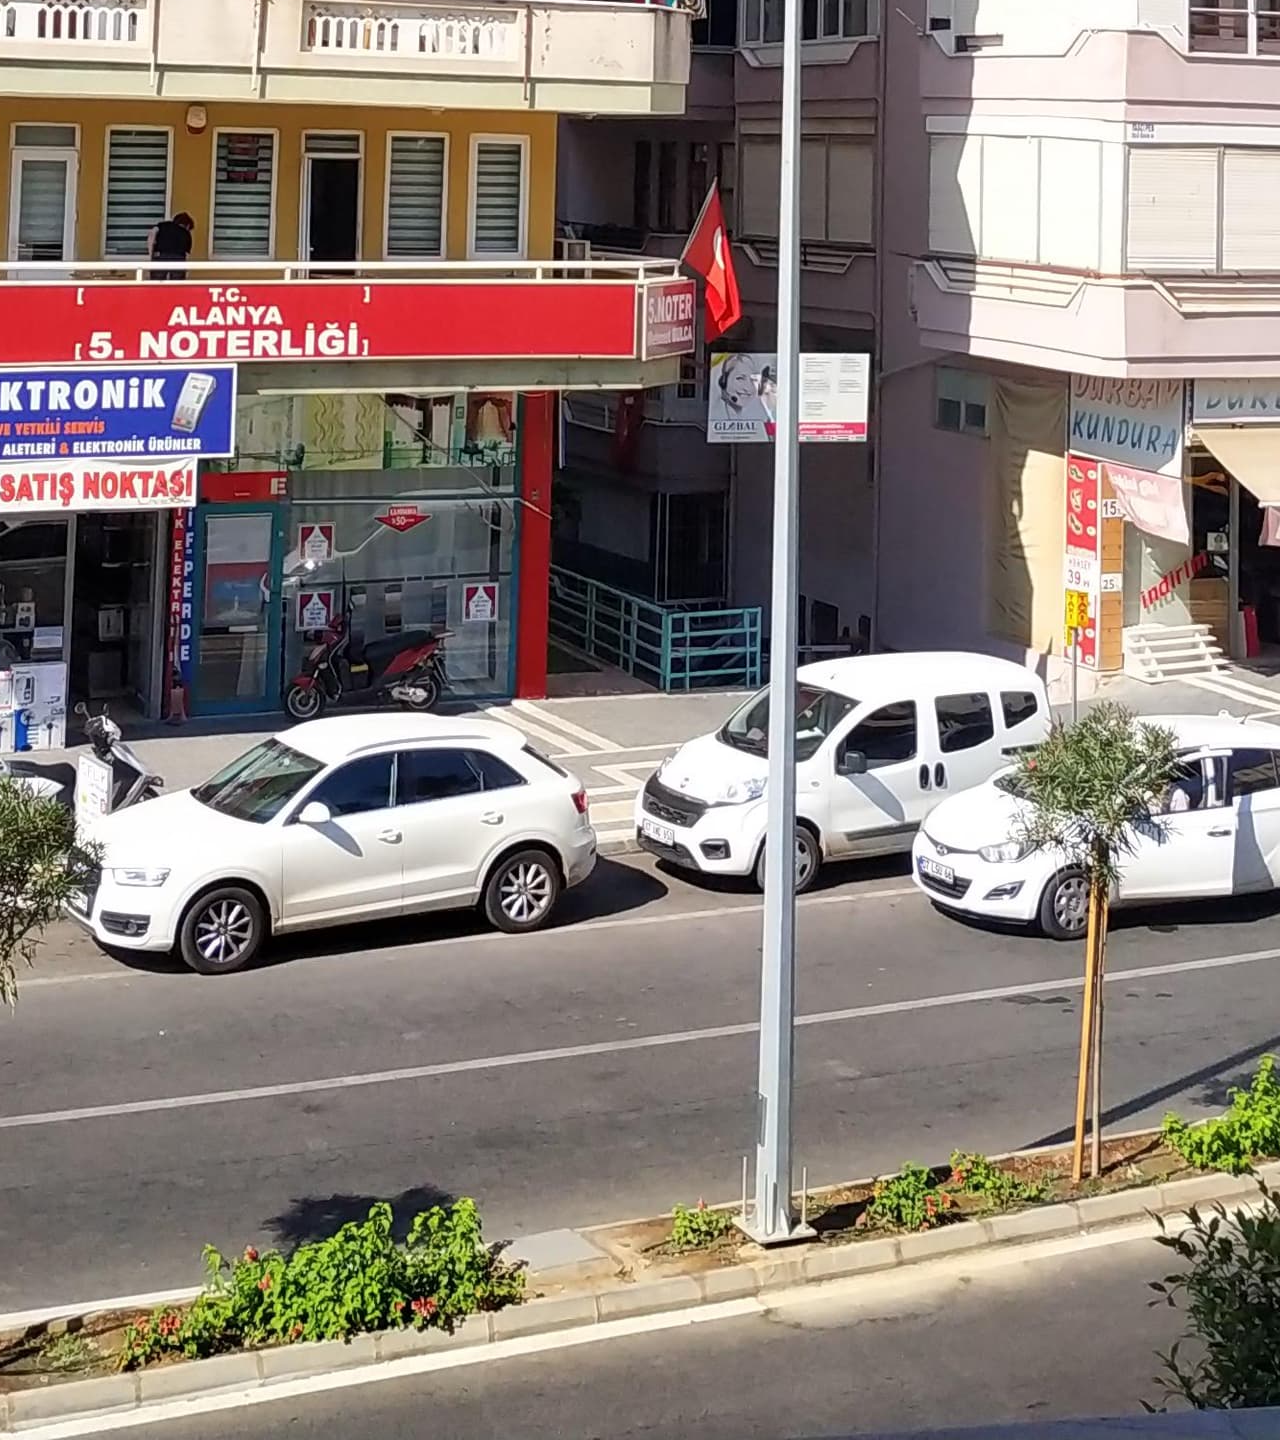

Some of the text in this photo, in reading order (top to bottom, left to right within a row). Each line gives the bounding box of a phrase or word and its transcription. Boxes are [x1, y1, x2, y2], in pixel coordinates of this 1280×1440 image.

[208, 287, 248, 303] T.C.
[167, 305, 283, 326] ALANYA
[88, 321, 359, 360] 5. NOTERLİĞİ
[14, 417, 61, 436] YETKİLİ
[63, 415, 105, 434] SERVİS
[1072, 410, 1178, 456] KUNDURA
[2, 437, 56, 456] ALETLERİ
[72, 434, 145, 454] ELEKTRONİK
[148, 436, 202, 452] ÜRÜNLER
[0, 471, 75, 507] SATIŞ
[82, 468, 194, 502] NOKTASI
[1140, 550, 1210, 610] indirim
